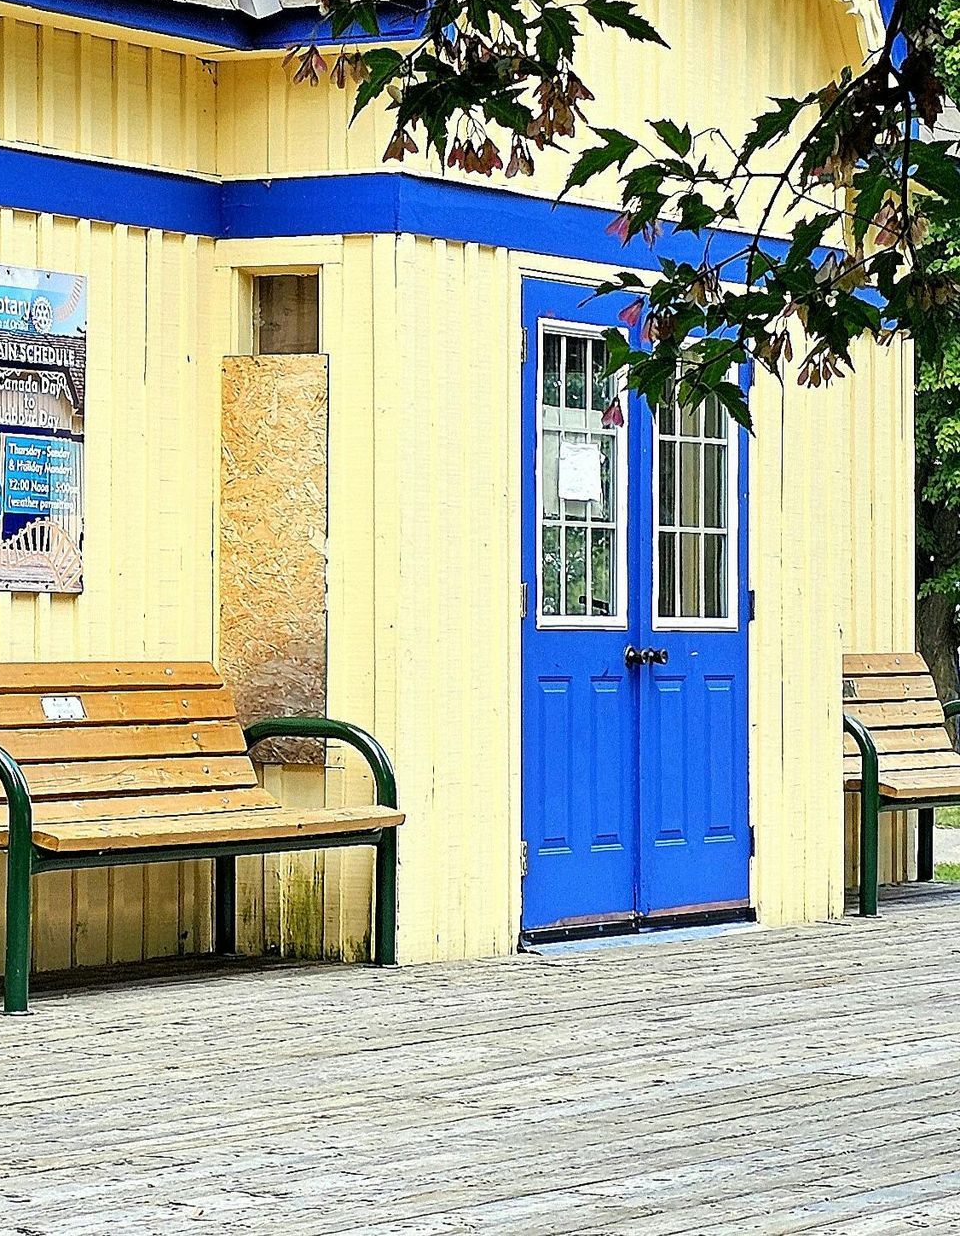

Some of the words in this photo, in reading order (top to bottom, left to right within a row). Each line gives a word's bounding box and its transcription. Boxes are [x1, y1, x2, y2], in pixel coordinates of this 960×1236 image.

[19, 344, 75, 367] SCHEDULE
[41, 376, 60, 399] Day
[24, 394, 35, 409] to
[40, 409, 59, 433] Day
[9, 443, 41, 459] Thursday
[47, 445, 70, 462] Sunday
[9, 458, 15, 471] &
[17, 459, 43, 475] Holiday
[9, 478, 30, 492] 12:00
[31, 479, 49, 493] Noon
[8, 495, 39, 509] (weather
